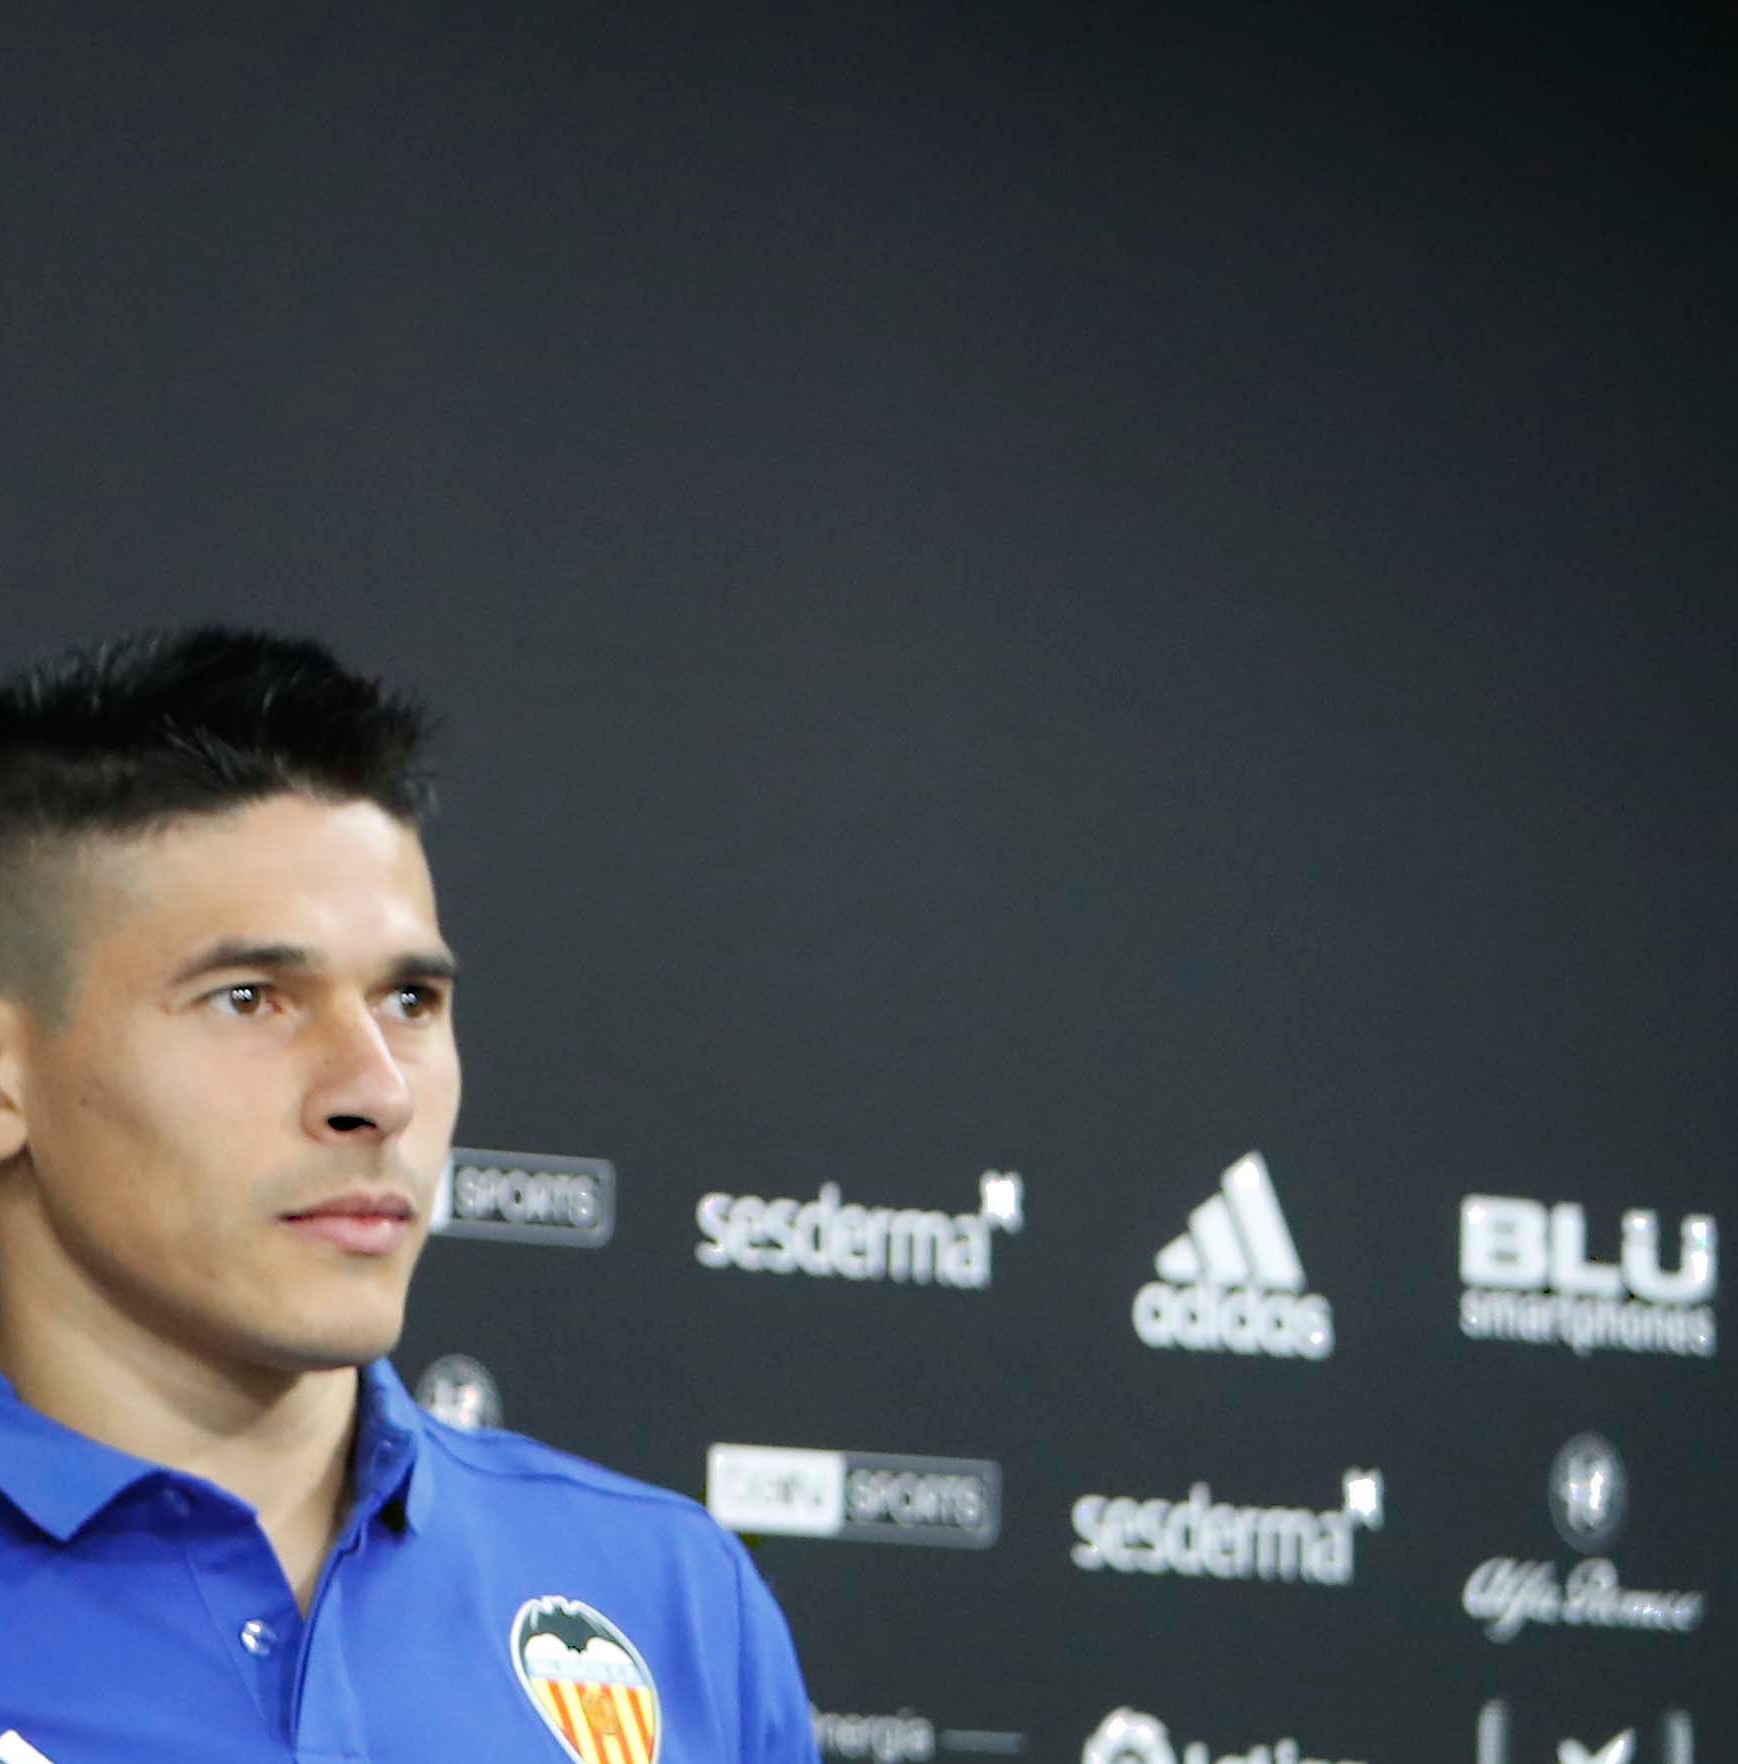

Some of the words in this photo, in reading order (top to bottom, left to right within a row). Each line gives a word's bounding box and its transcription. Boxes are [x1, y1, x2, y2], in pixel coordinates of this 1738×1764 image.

[695, 1182, 993, 1288] sesderma
[1131, 1280, 1335, 1361] adidas
[1071, 1480, 1354, 1586] sesderma
